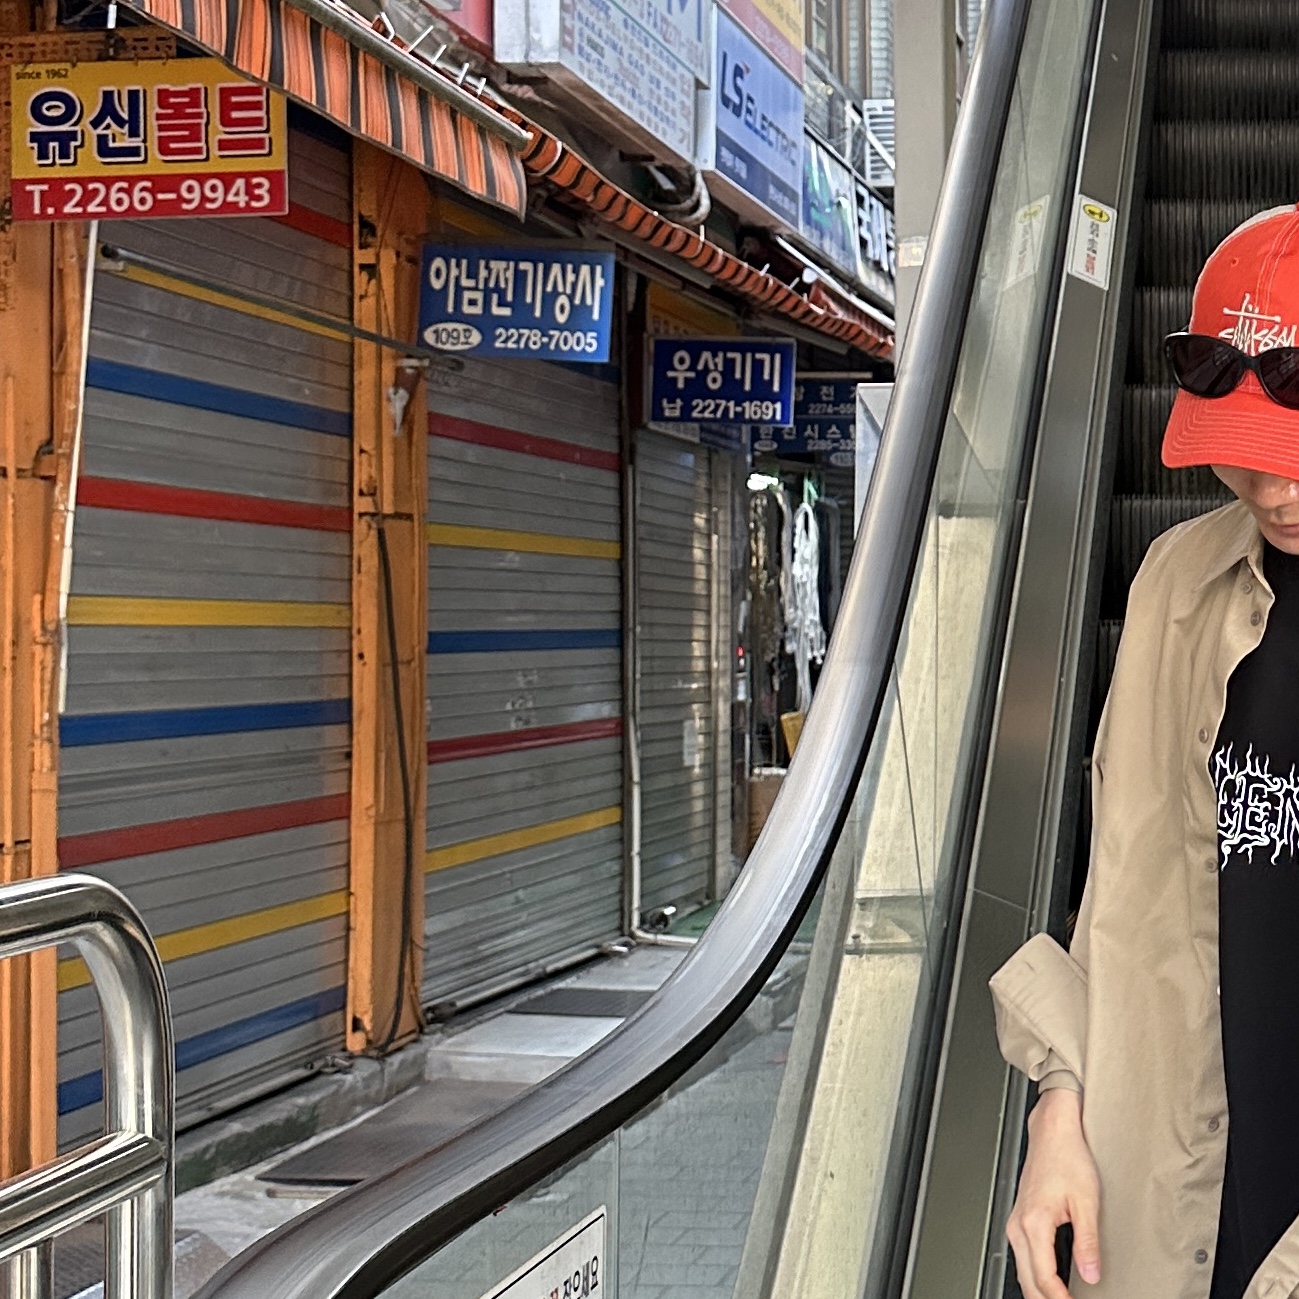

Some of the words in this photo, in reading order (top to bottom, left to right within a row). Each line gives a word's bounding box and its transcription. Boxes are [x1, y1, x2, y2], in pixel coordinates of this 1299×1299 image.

[15, 70, 42, 81] since
[720, 51, 747, 119] LS
[28, 82, 271, 164] 유신볼트
[429, 256, 605, 325] 아남전기상사
[432, 327, 474, 346] 109호
[494, 326, 598, 353] 2278-7005
[666, 350, 781, 393] 우성기기
[691, 399, 782, 421] 2271-1691
